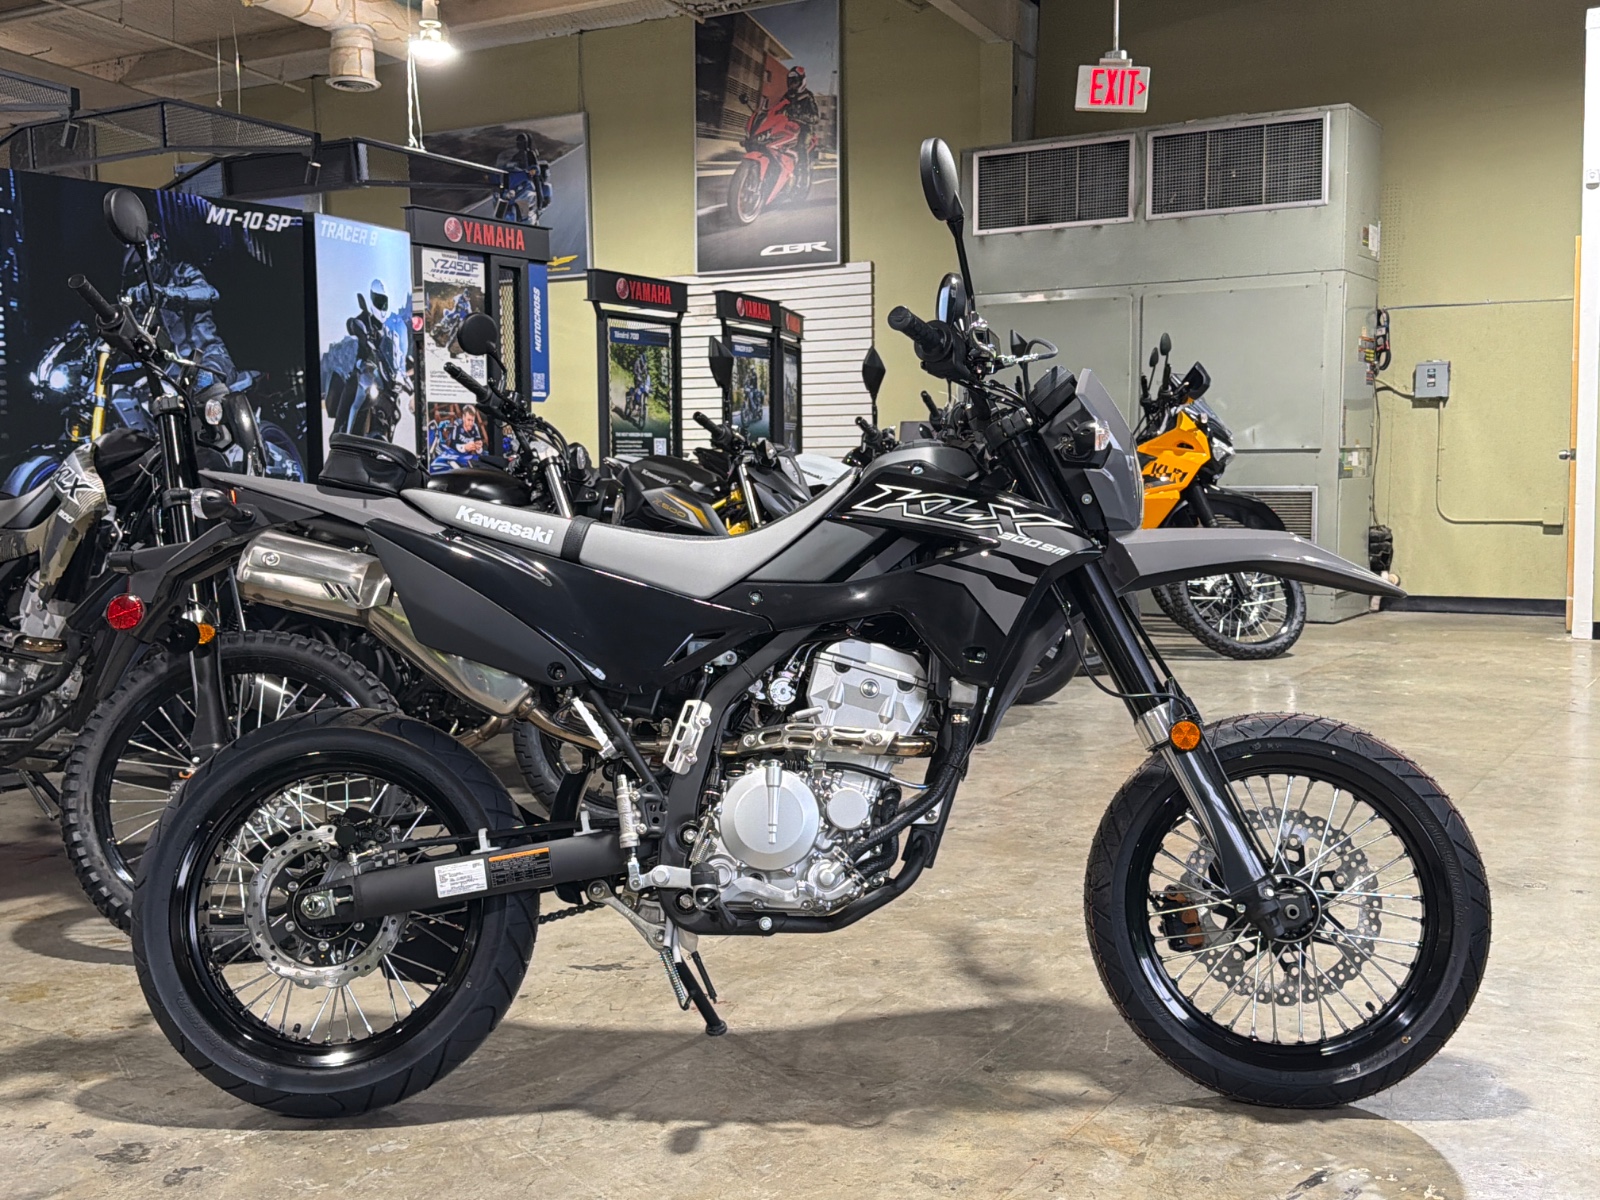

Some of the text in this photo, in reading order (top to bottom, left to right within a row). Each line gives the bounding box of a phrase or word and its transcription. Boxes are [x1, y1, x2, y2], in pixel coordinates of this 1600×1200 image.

[1089, 68, 1140, 106] EXIT
[206, 204, 292, 233] MT-10 SP
[320, 220, 379, 247] TRACER 9
[463, 221, 525, 251] YAMAHA
[760, 241, 832, 257] CBR
[430, 257, 479, 273] YZ450F
[629, 280, 672, 305] YAMAHA
[533, 286, 542, 353] MOTOCROSS
[743, 300, 771, 321] YAMAHA
[851, 483, 1074, 536] KLX
[455, 505, 554, 545] Kawasaki
